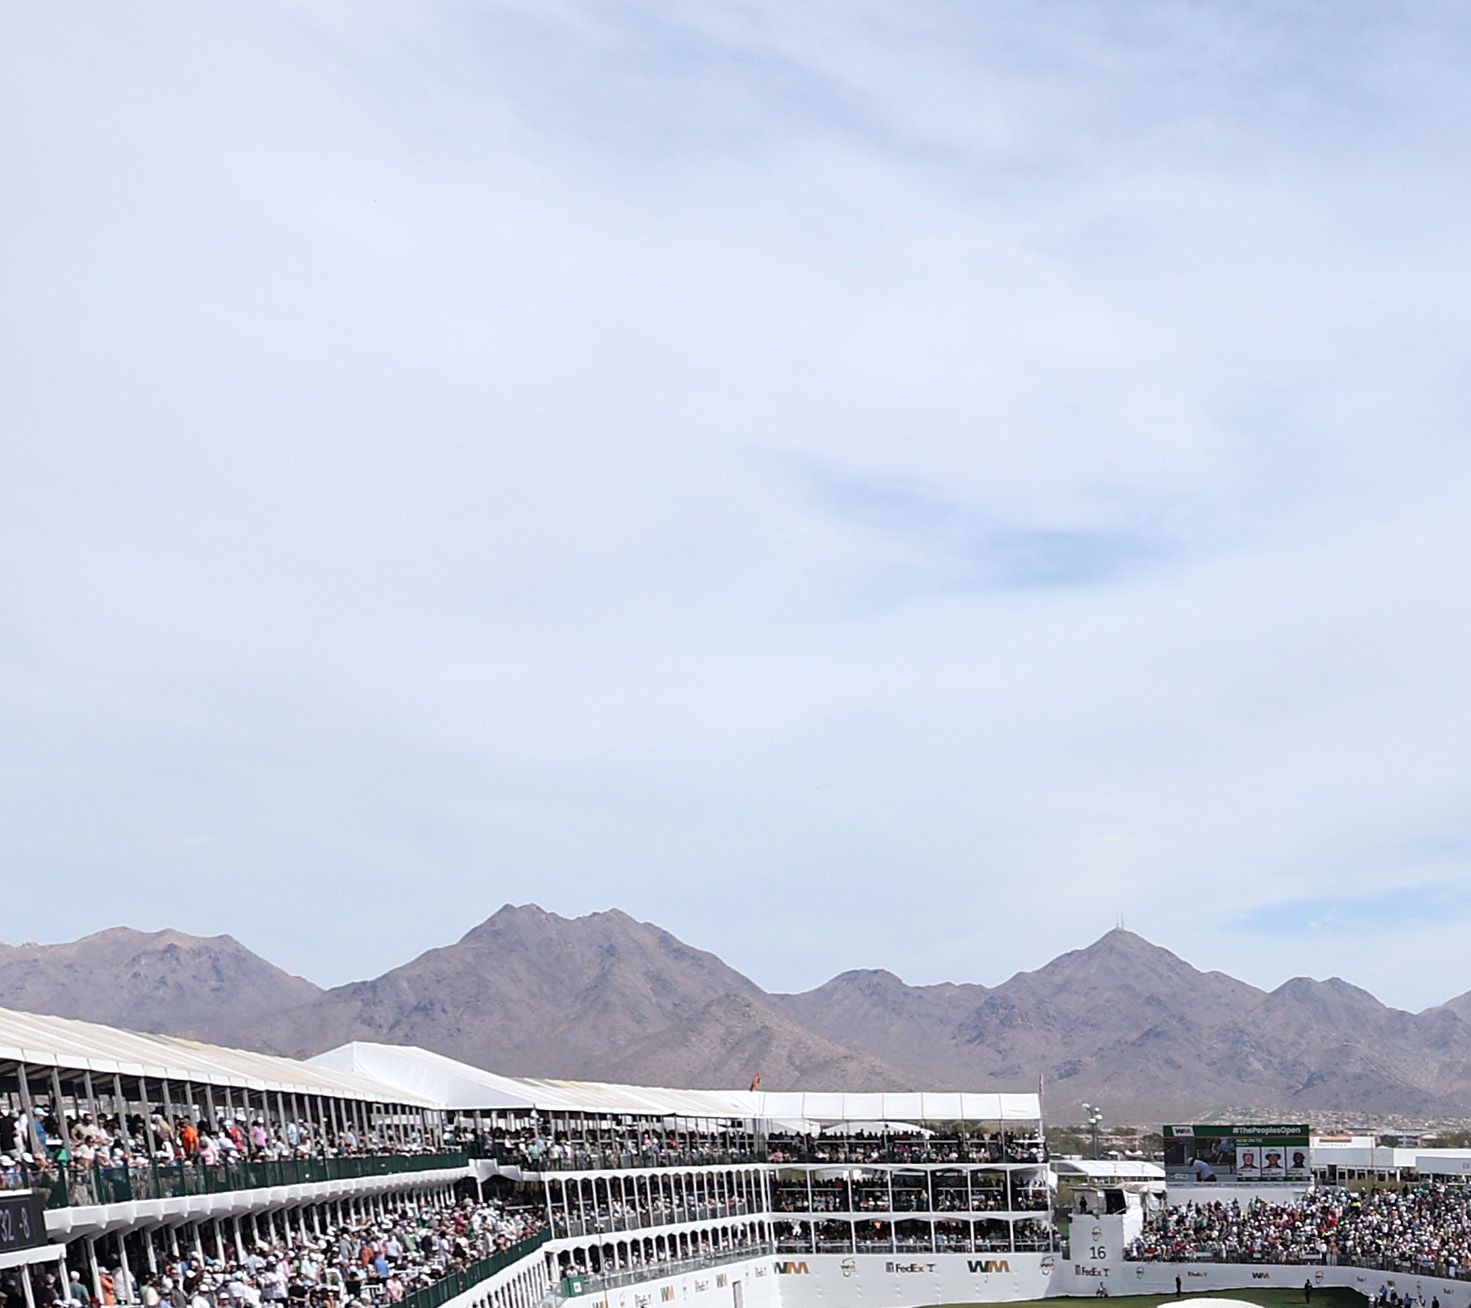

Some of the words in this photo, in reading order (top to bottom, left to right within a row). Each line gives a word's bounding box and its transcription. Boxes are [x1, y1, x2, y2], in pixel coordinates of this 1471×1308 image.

[1233, 1127, 1301, 1135] #ThePeoplesOpen
[1090, 1246, 1106, 1259] 16
[895, 1263, 925, 1273] FedEx
[967, 1260, 1009, 1273] WM
